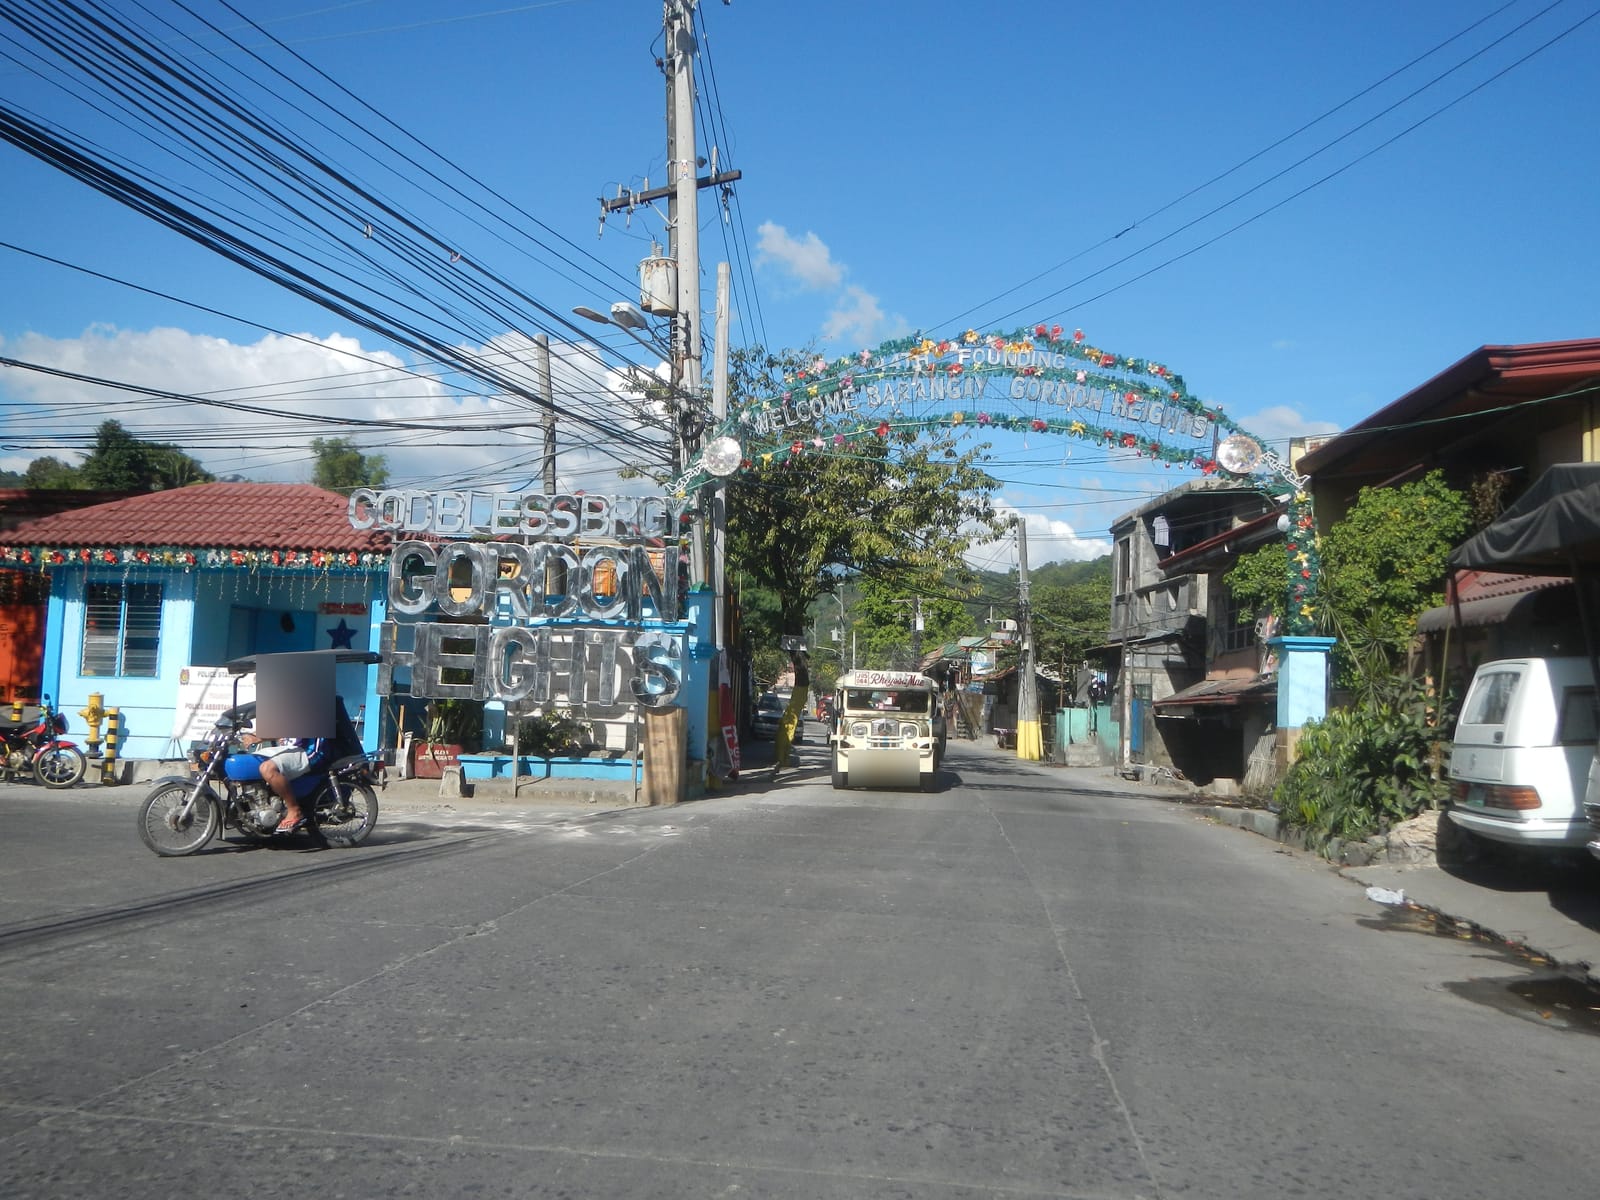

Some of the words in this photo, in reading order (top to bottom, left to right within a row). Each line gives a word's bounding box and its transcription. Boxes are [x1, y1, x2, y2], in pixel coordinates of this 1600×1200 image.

[958, 348, 1066, 370] FOUNDING
[754, 388, 857, 434] WELCOME
[867, 376, 989, 408] BARANGAY
[1010, 376, 1104, 411] GORDON
[1111, 392, 1208, 438] HEIGHTS
[388, 540, 679, 622] GORDON
[376, 622, 683, 708] HEIGHTS
